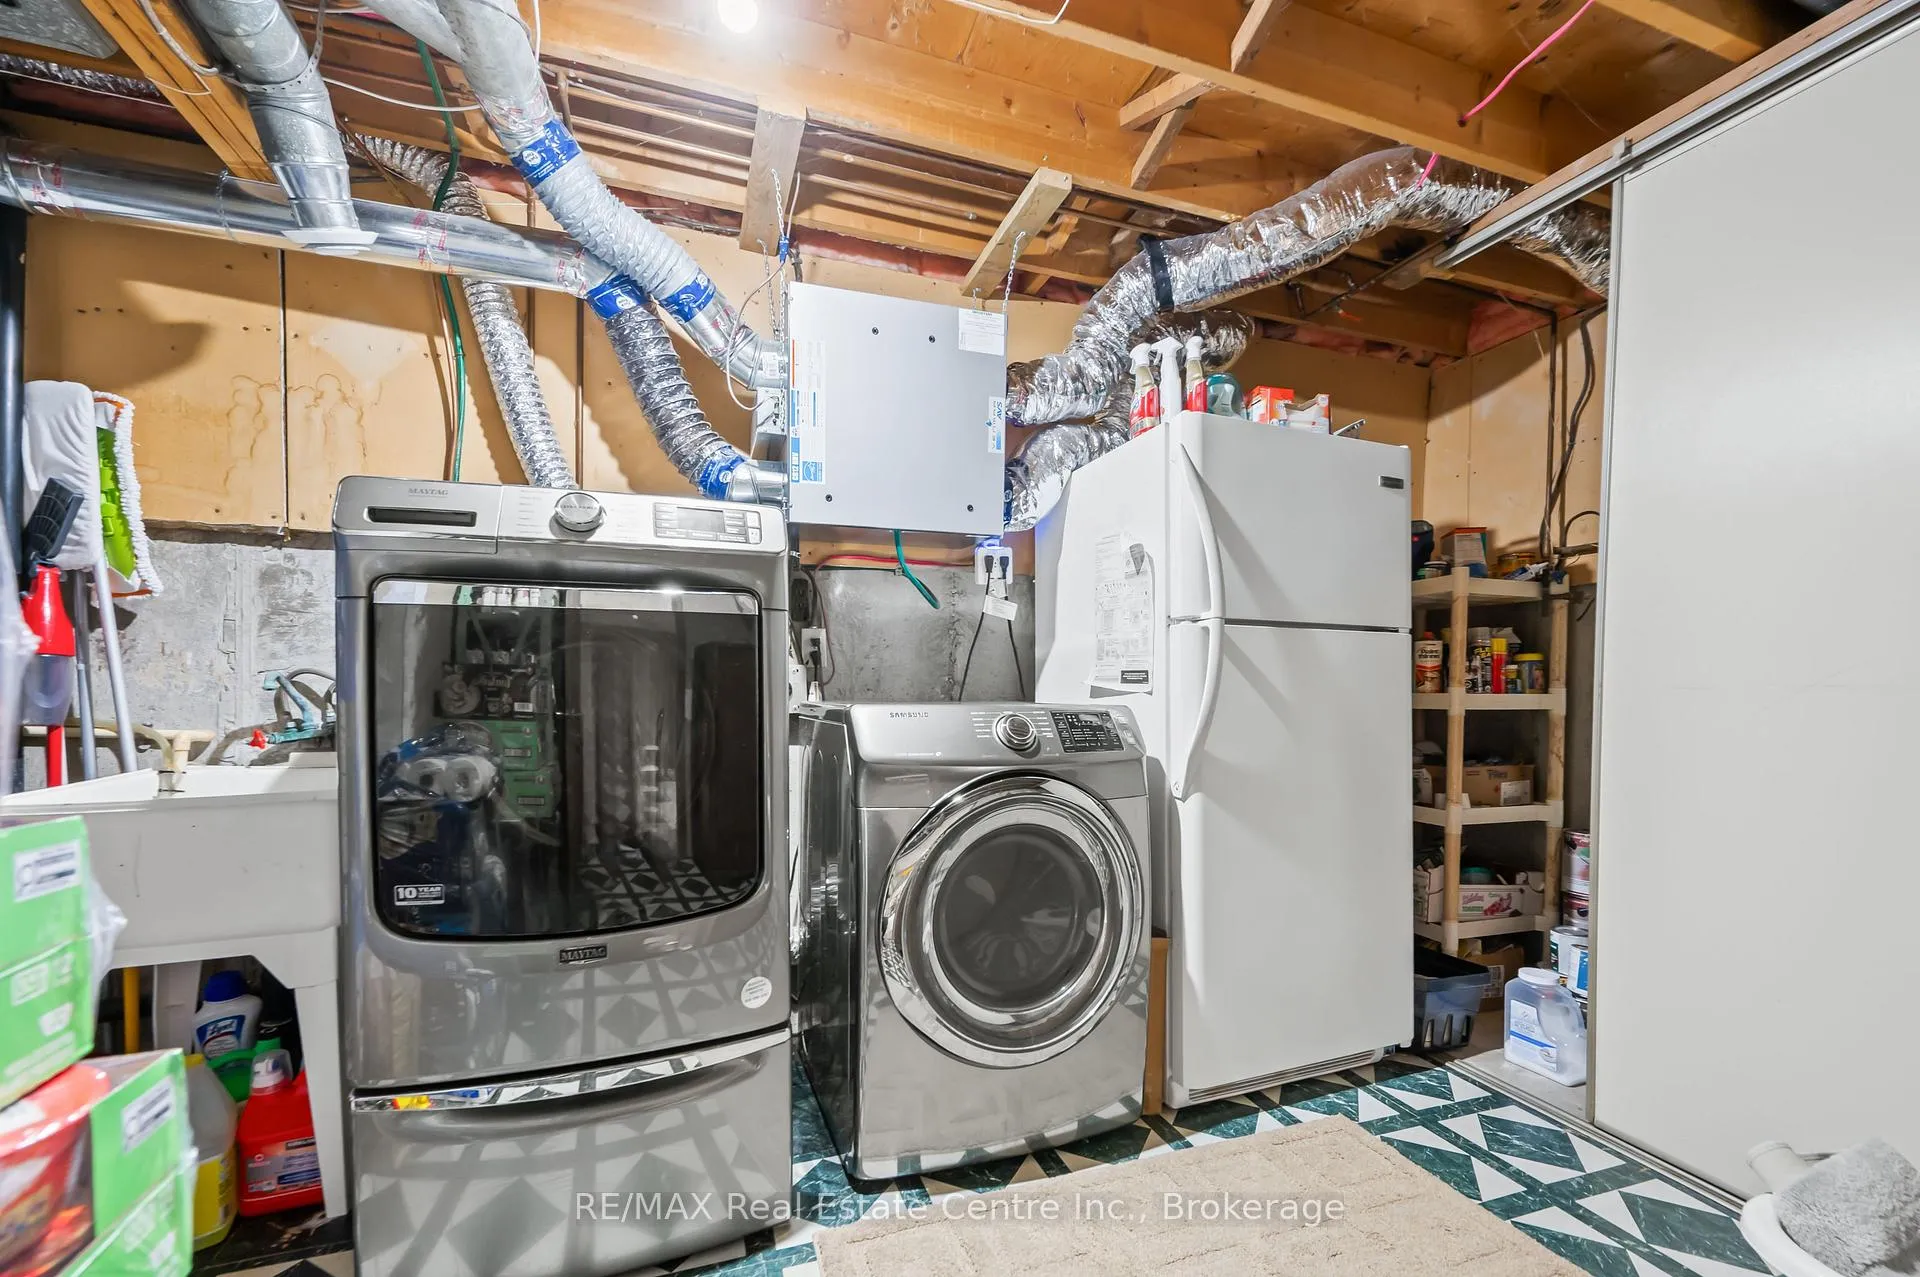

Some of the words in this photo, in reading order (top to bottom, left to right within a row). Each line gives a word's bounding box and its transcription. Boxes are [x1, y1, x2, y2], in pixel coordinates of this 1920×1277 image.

[408, 487, 449, 496] MAYTAG
[889, 711, 929, 719] SAMSUNG
[397, 887, 417, 899] 10
[560, 946, 606, 963] MAYTAG
